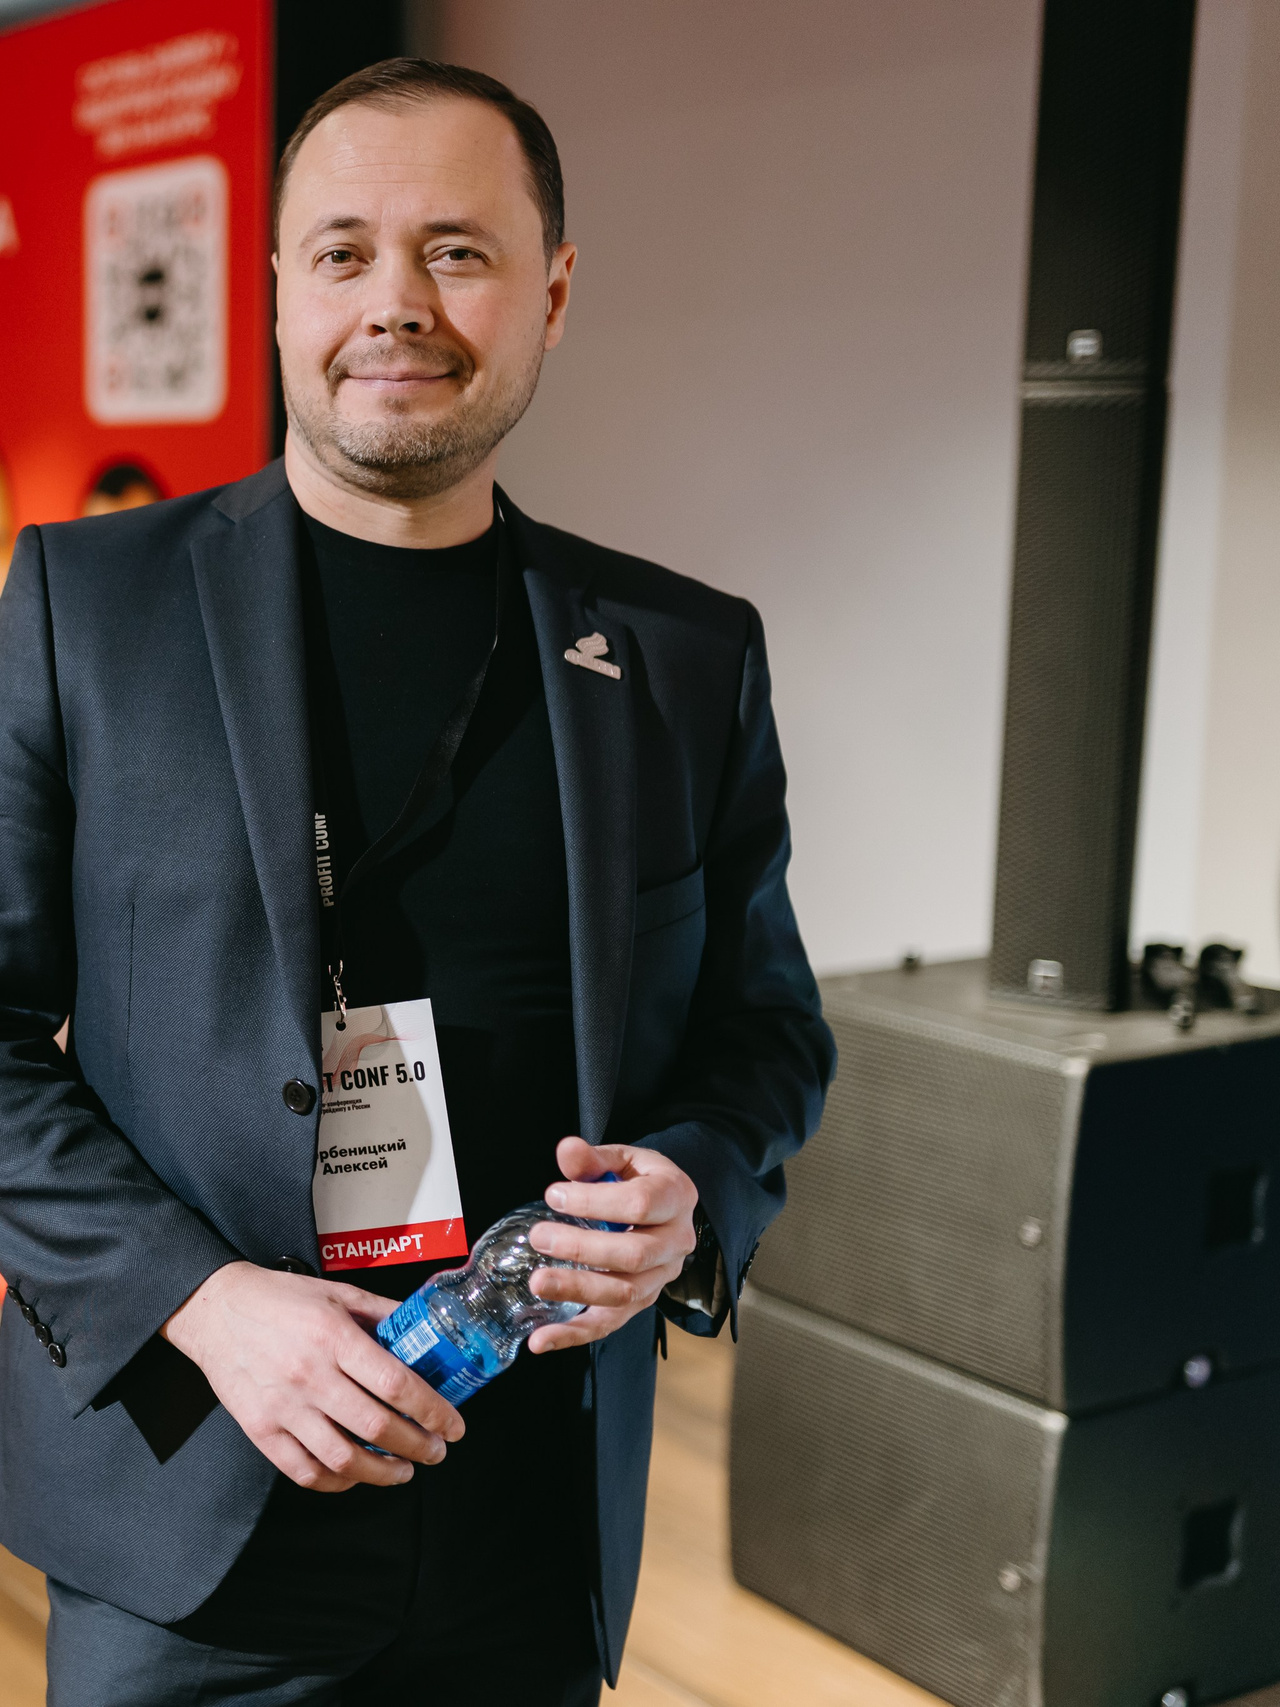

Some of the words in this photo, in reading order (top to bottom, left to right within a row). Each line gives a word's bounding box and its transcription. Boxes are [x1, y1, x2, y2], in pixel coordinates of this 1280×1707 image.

[317, 855, 334, 907] PROFIT
[340, 1065, 389, 1091] CONF
[396, 1061, 426, 1084] 5.0
[318, 1139, 406, 1162] рбеницкий
[323, 1157, 388, 1175] Алексей
[322, 1234, 424, 1260] СТАНДАРТ
